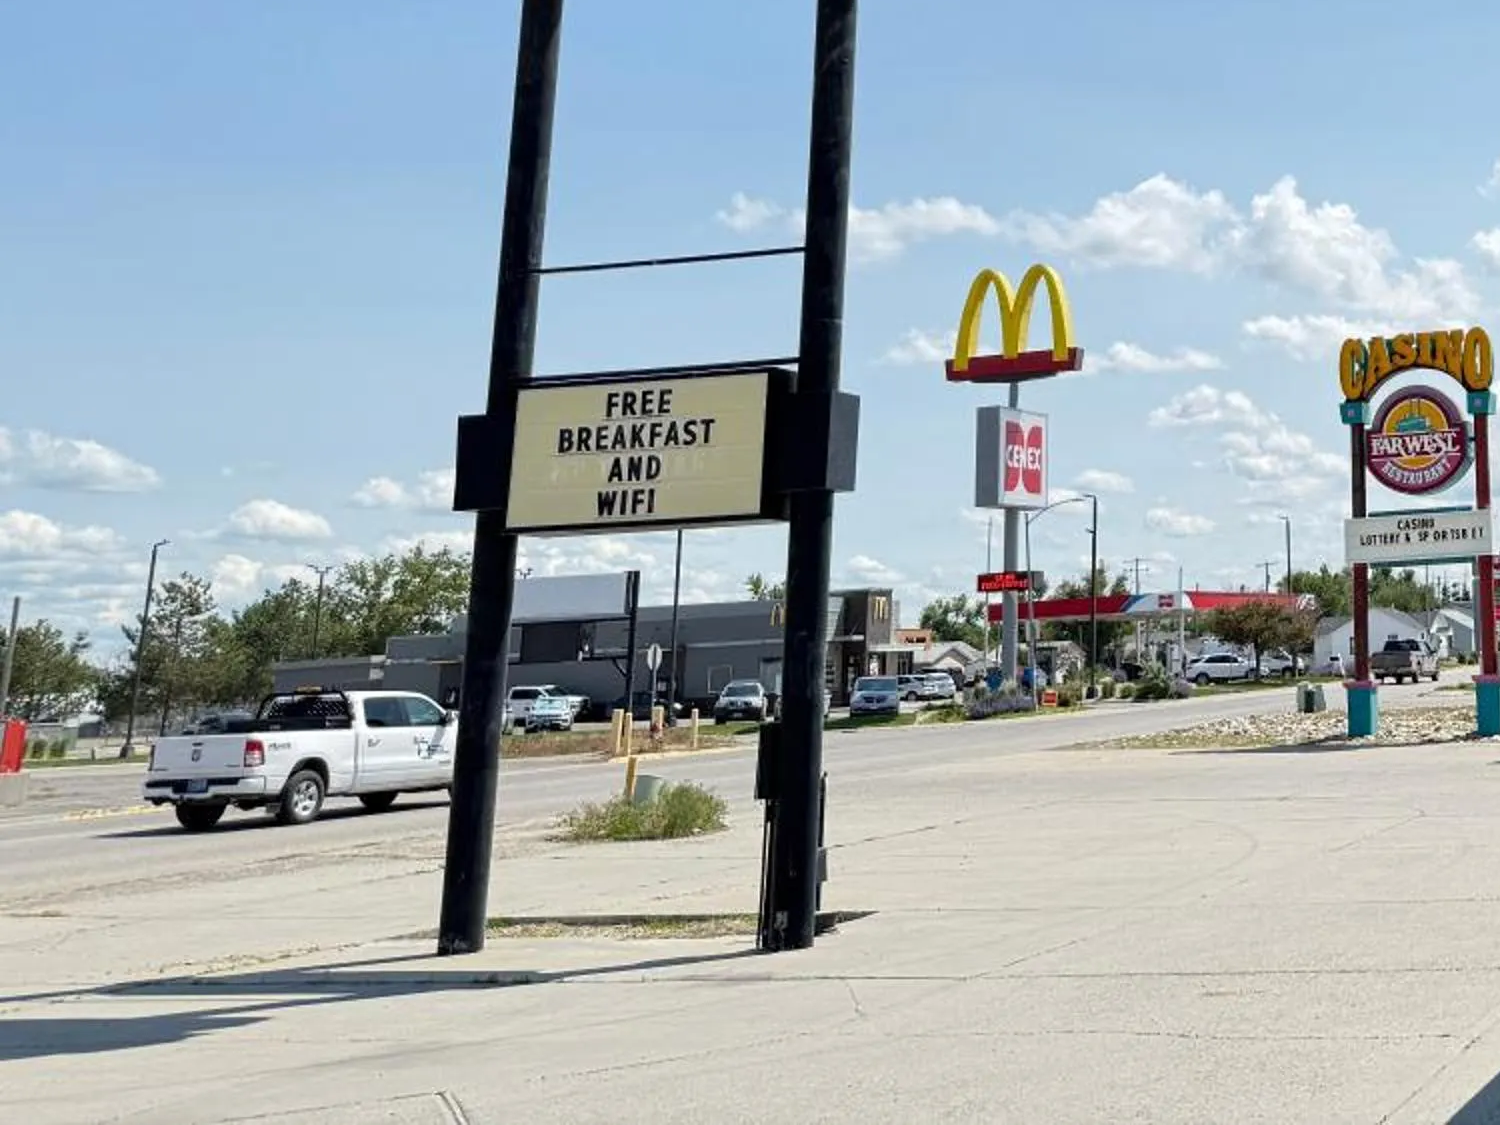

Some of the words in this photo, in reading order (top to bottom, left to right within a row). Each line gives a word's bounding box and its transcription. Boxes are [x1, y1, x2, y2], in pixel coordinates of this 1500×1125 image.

[1339, 327, 1493, 400] CASINO
[604, 389, 674, 418] FREE
[557, 419, 716, 454] BREAKFAST
[607, 455, 662, 483] AND
[1006, 443, 1041, 471] CENEX
[1382, 456, 1451, 484] RESTAURANT
[597, 489, 657, 517] WIFI
[1397, 518, 1435, 531] CASINO
[1360, 533, 1400, 546] LOTTERY
